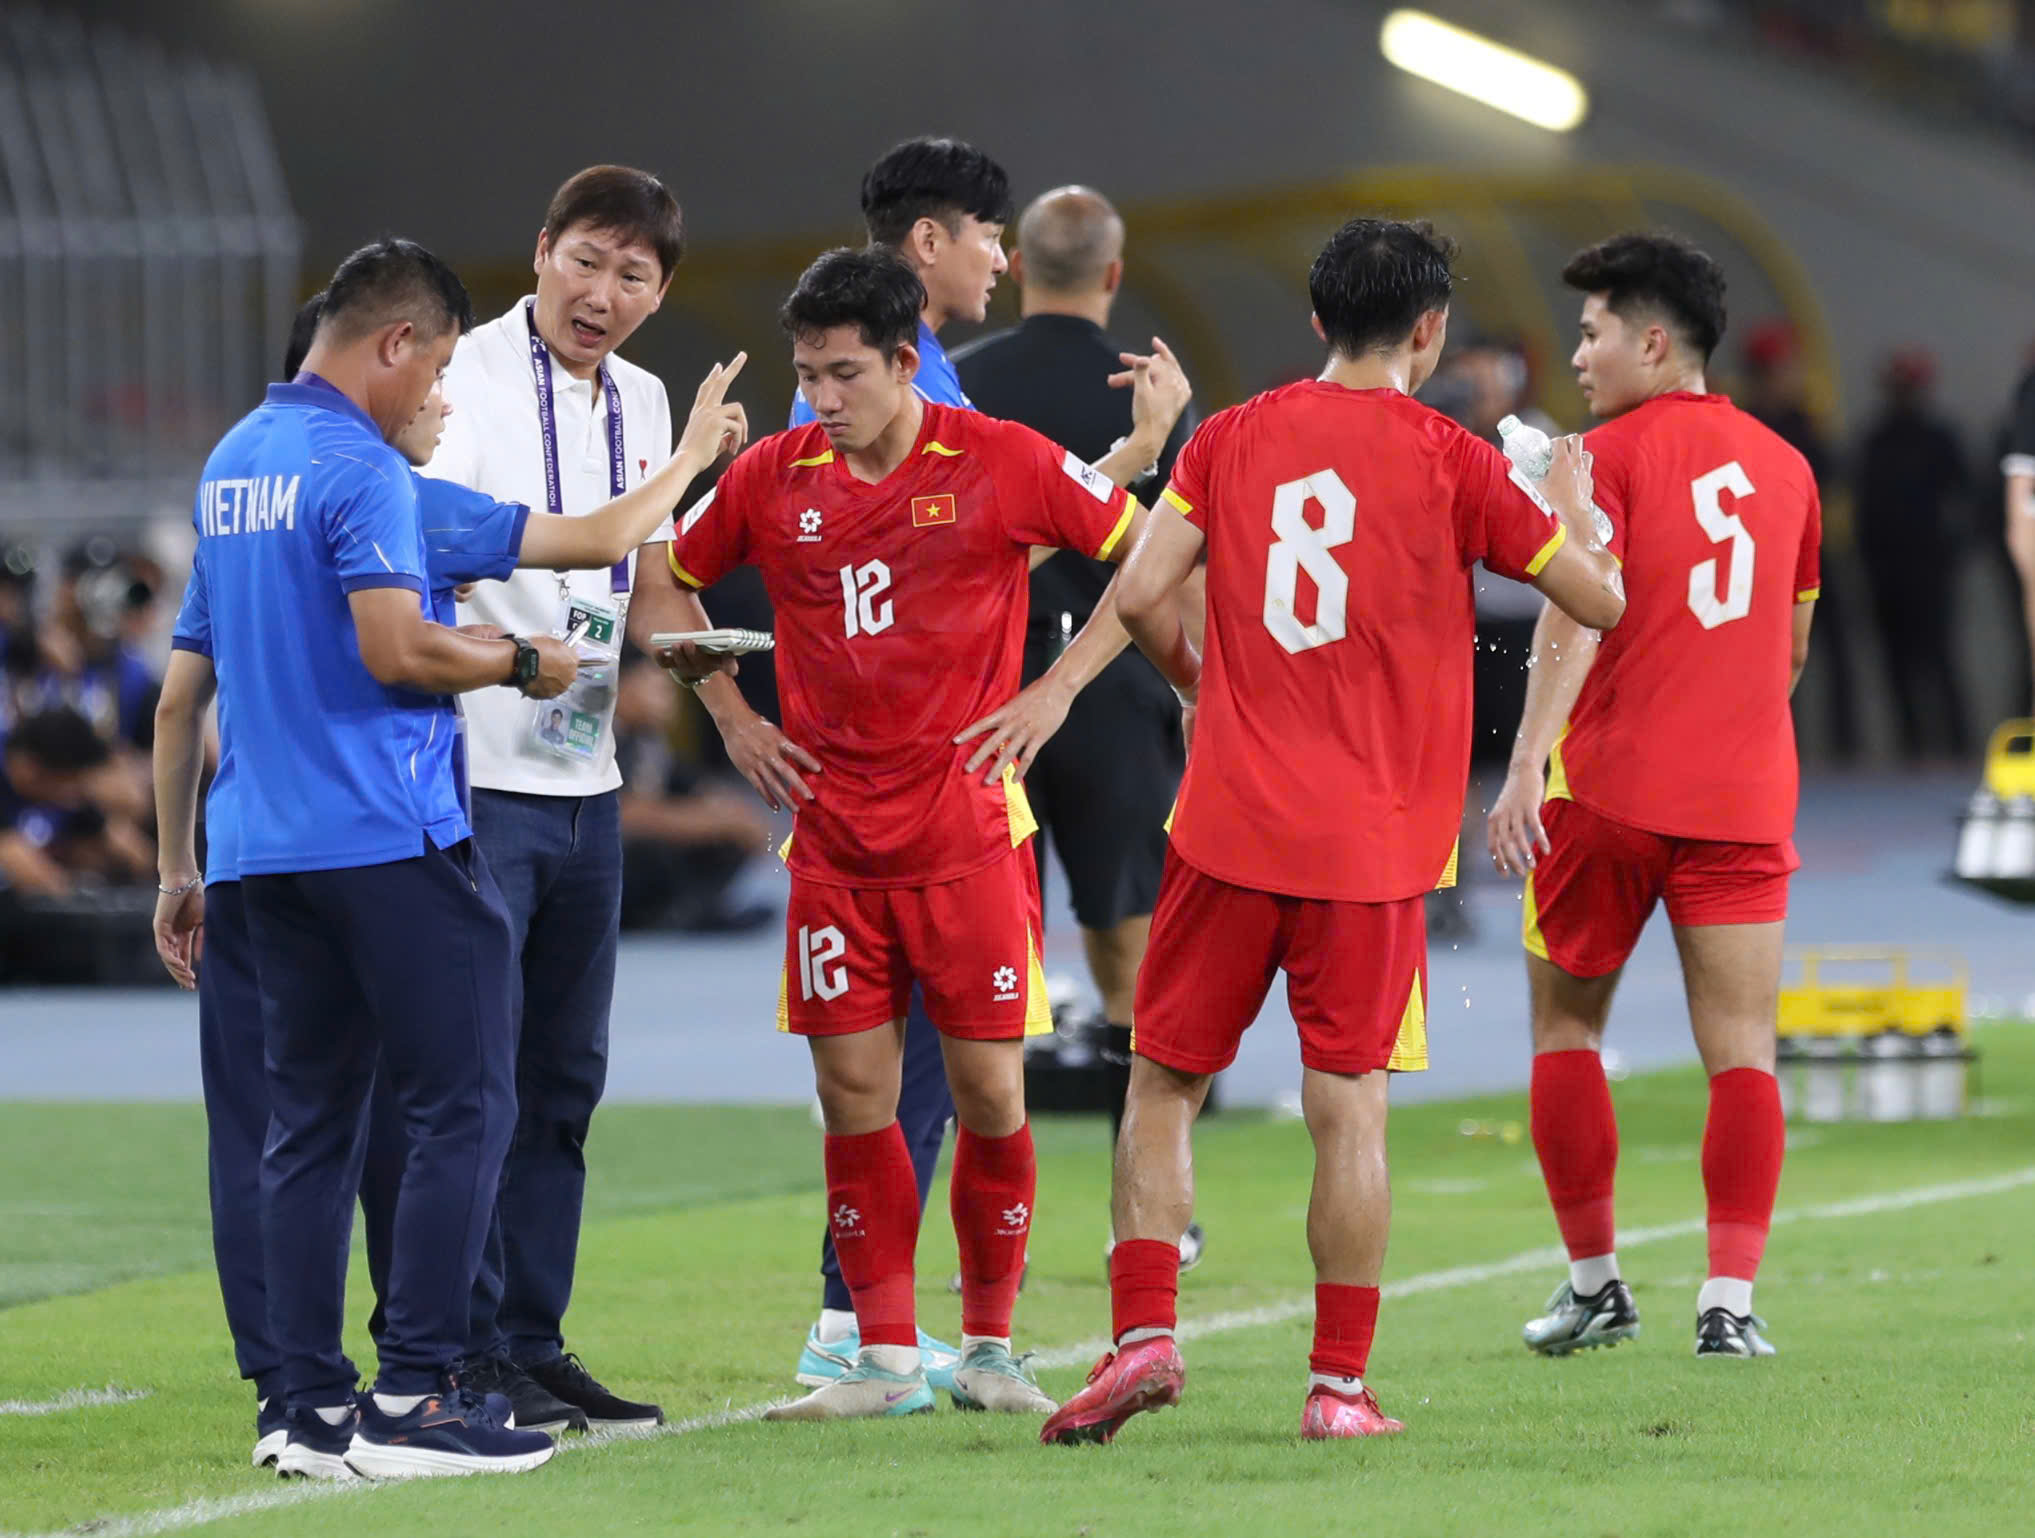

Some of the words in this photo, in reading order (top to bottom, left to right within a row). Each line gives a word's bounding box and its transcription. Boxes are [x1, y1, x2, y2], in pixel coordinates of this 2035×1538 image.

[534, 358, 545, 385] ASIAN
[538, 387, 550, 432] FOOTBALL
[613, 415, 623, 460] FOOTBALL
[543, 434, 557, 507] CONFEDERATION
[615, 461, 625, 489] ASIAN
[200, 474, 301, 537] VIETNAM
[1263, 467, 1357, 655] 8
[1687, 460, 1756, 630] 5
[839, 558, 895, 640] 12
[594, 624, 603, 639] 2
[798, 924, 850, 1002] 12
